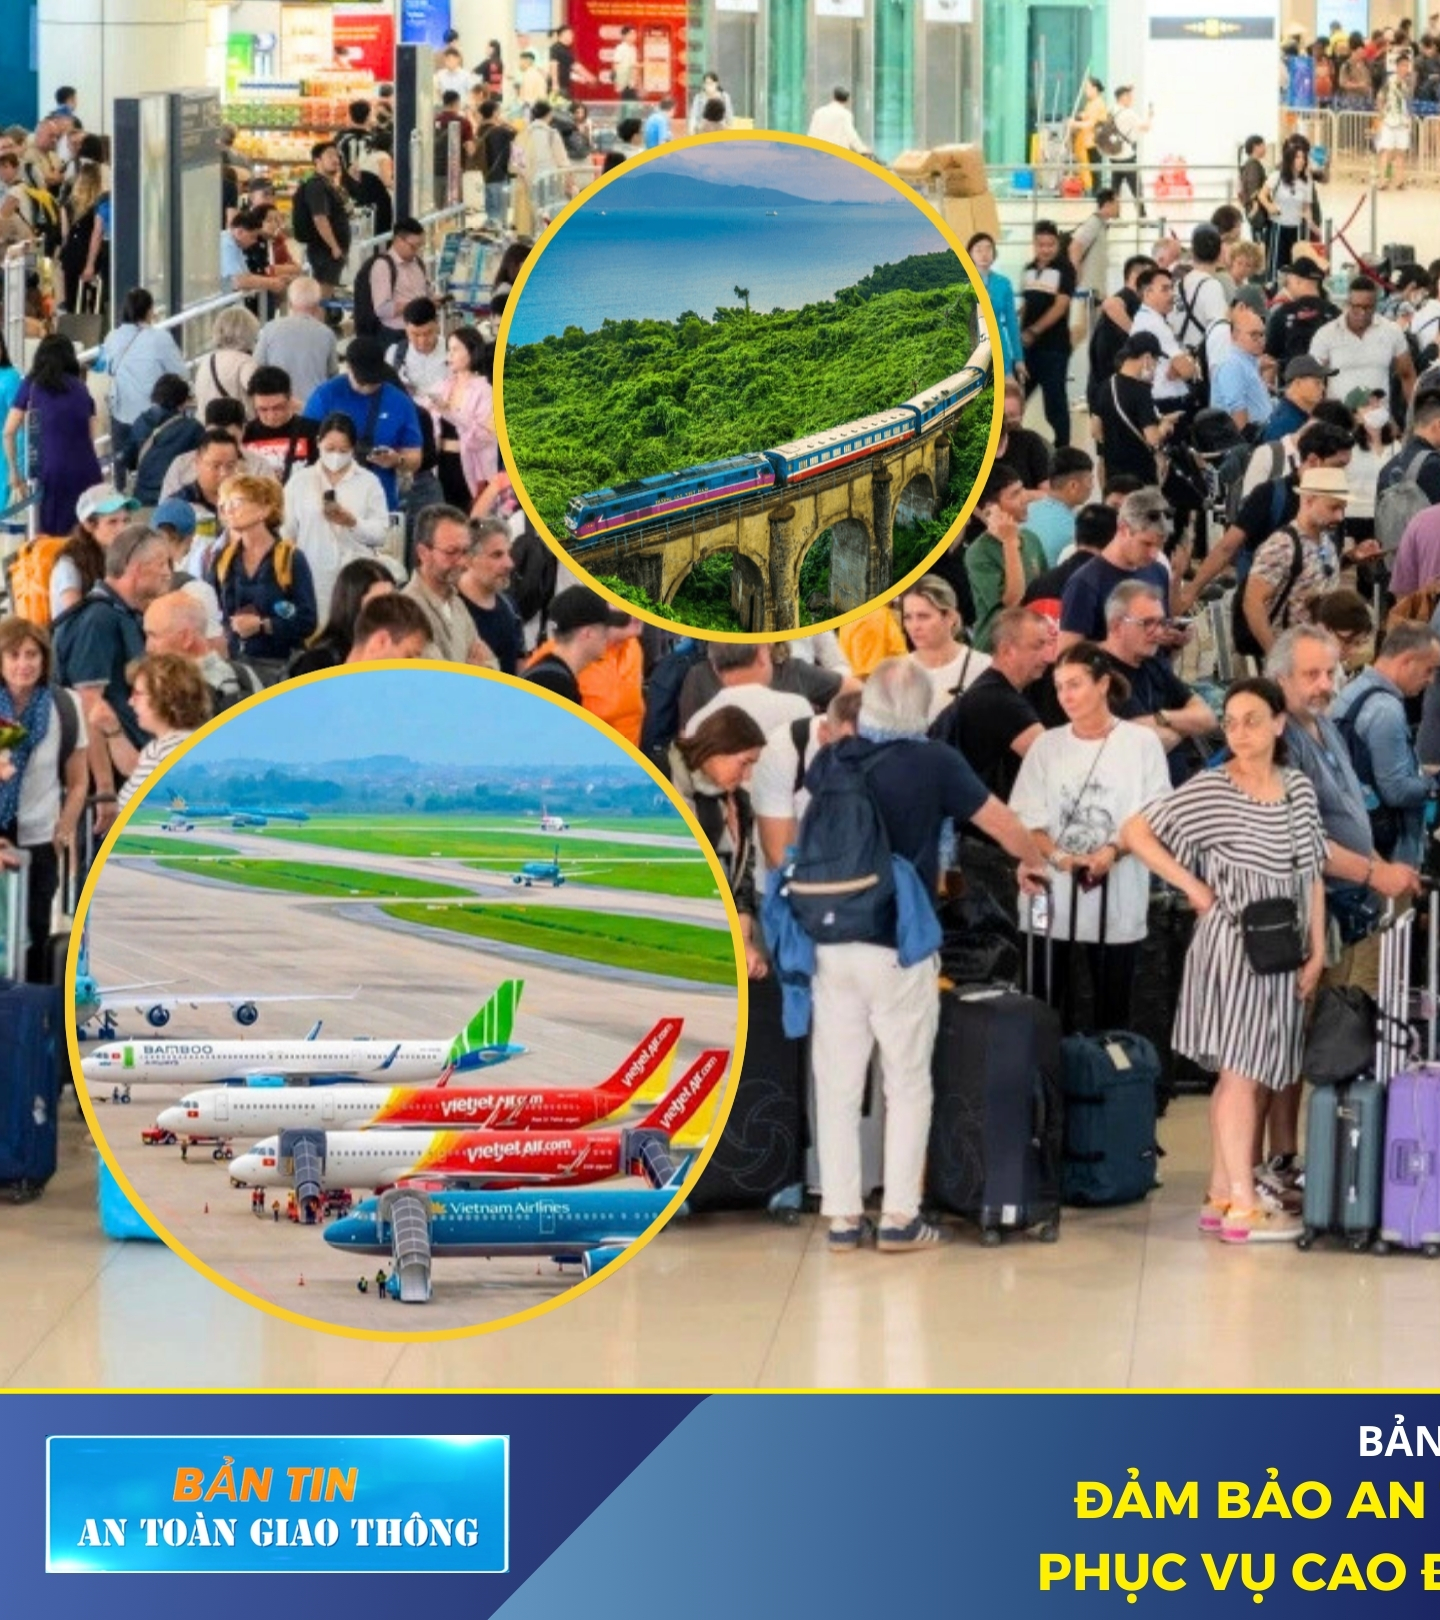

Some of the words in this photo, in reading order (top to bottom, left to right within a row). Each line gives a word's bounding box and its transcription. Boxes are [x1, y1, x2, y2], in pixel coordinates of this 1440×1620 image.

[144, 1045, 213, 1054] BAMBOO
[450, 1201, 512, 1214] Vietnam
[515, 1200, 570, 1214] Airlines
